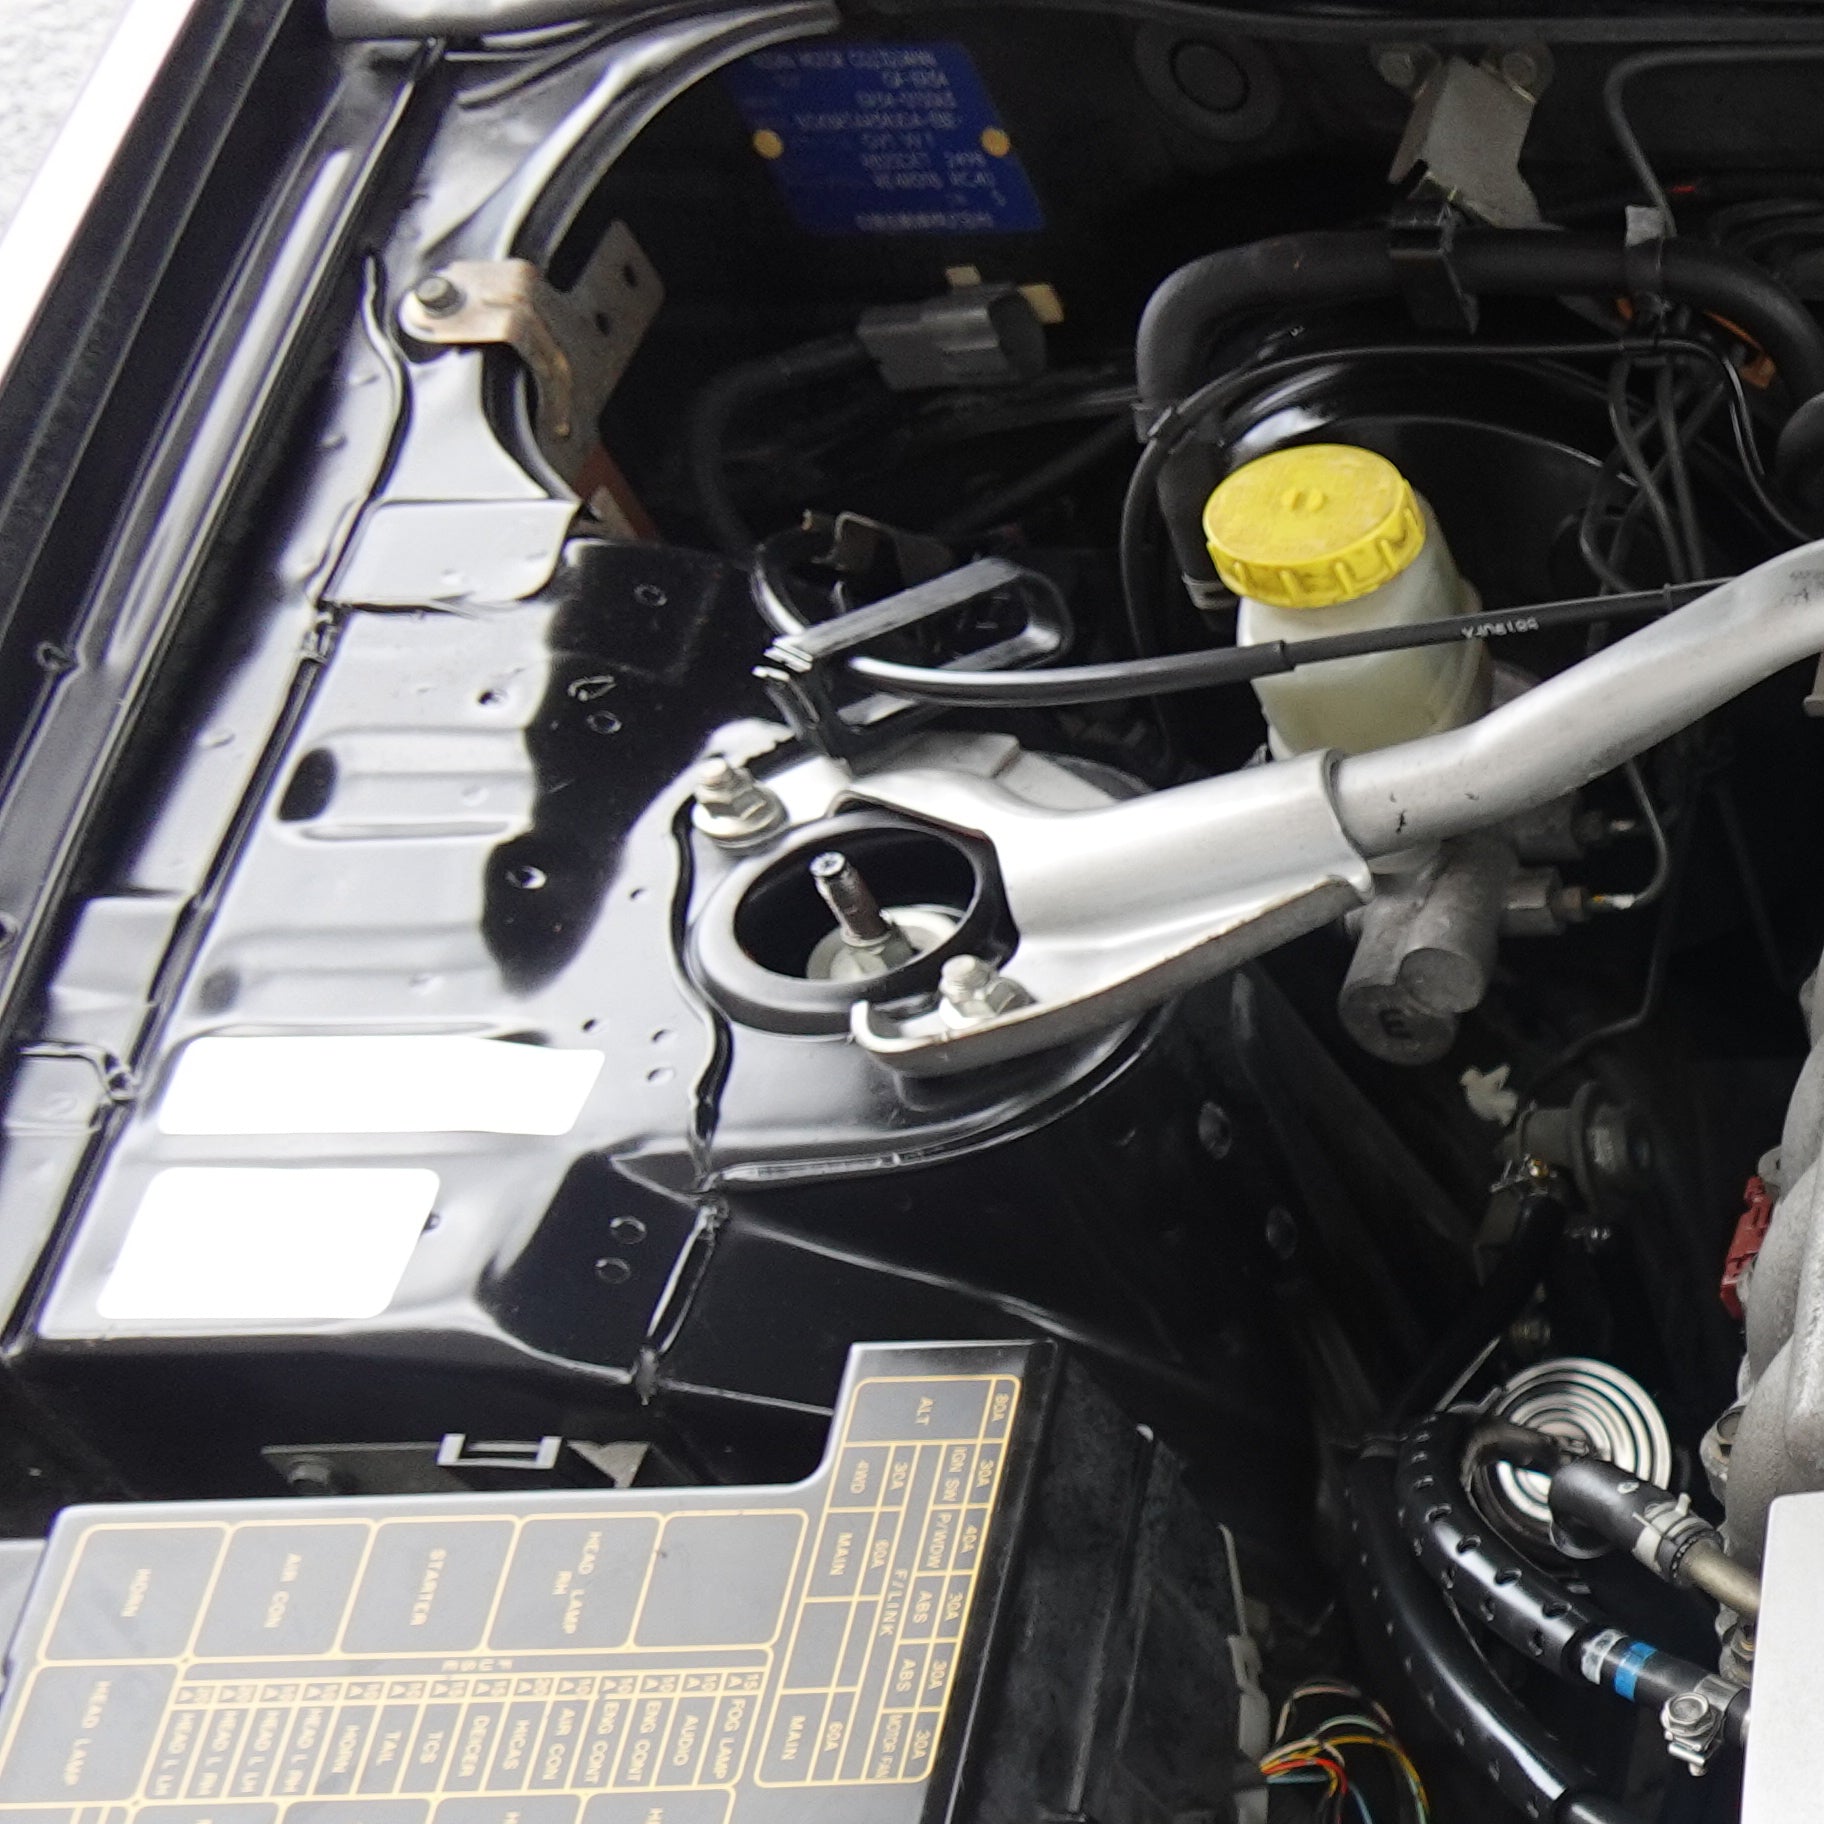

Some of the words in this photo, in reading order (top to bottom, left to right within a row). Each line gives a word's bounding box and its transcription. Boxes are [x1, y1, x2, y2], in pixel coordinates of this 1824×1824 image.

[915, 1396, 935, 1426] ALT
[849, 1459, 870, 1494] 4WD
[889, 1461, 908, 1490] 30A
[976, 1459, 995, 1488] 30A
[829, 1532, 853, 1576] MAIN
[961, 1524, 979, 1554] 40A
[912, 1590, 933, 1625] ABS
[944, 1592, 964, 1622] 30A
[895, 1658, 917, 1693] ABS
[927, 1659, 948, 1691] 30A
[723, 1698, 747, 1733] FOG
[672, 1715, 699, 1767] AUDIO
[780, 1715, 806, 1761] MAIN
[911, 1729, 932, 1761] 30A
[541, 1743, 566, 1781] CON
